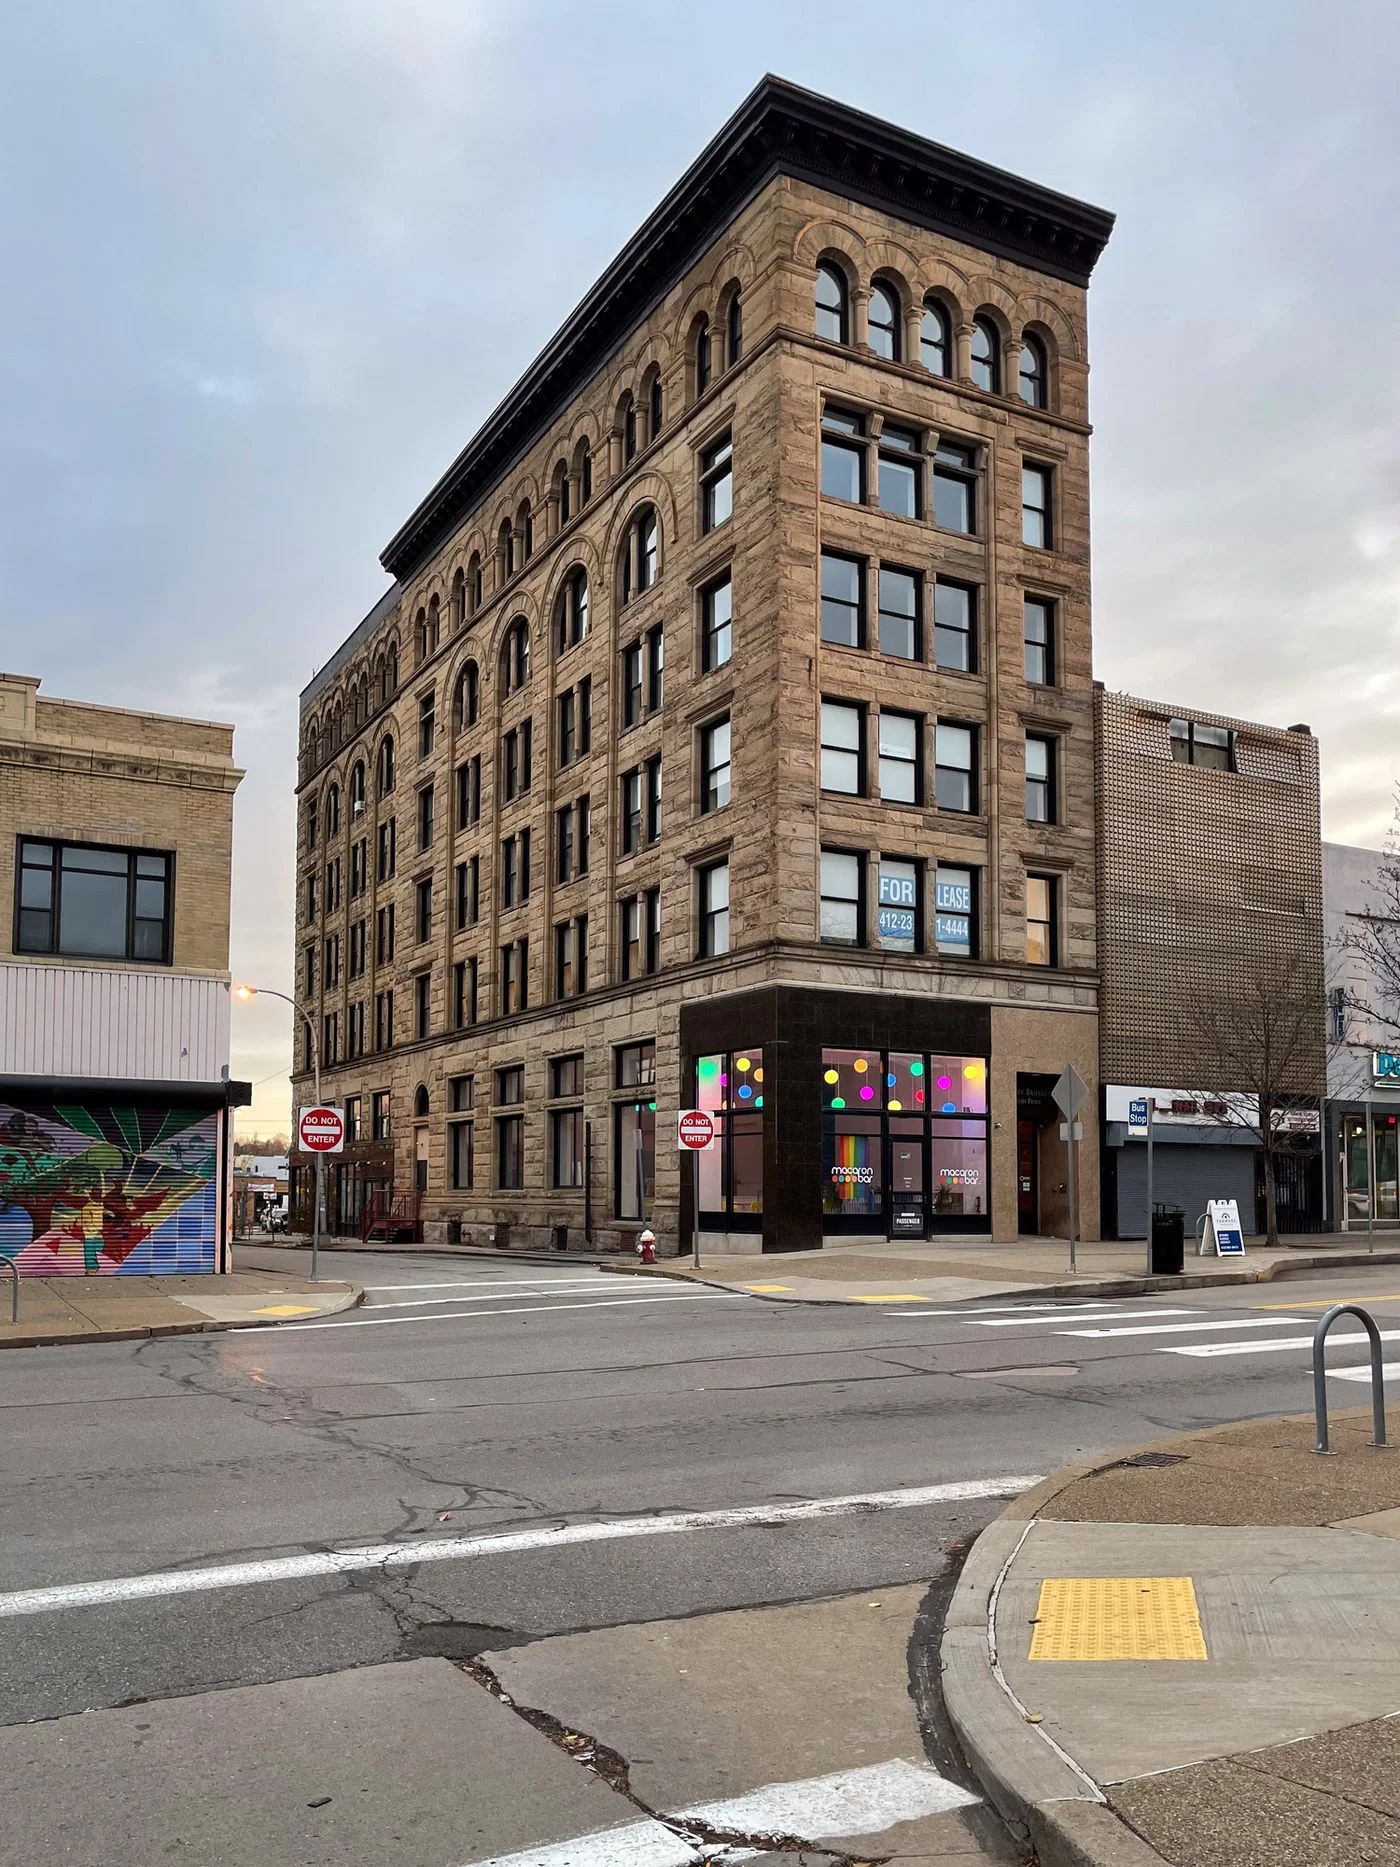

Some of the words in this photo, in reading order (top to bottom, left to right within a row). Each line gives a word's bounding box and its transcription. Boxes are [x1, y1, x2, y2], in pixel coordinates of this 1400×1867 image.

[880, 878, 913, 903] FOR
[937, 884, 970, 909] LEASE
[879, 912, 913, 930] 412-23
[936, 917, 969, 936] 1-4444
[1131, 1103, 1145, 1112] Bus
[305, 1116, 318, 1125] DO
[320, 1117, 338, 1125] NOT
[683, 1118, 694, 1126] DO
[695, 1118, 709, 1126] NOT
[1129, 1113, 1147, 1124] Stop
[307, 1135, 335, 1143] ENTER
[831, 1166, 874, 1175] macaron
[940, 1168, 979, 1177] macaron
[857, 1174, 874, 1183] bar
[964, 1175, 979, 1185] bar
